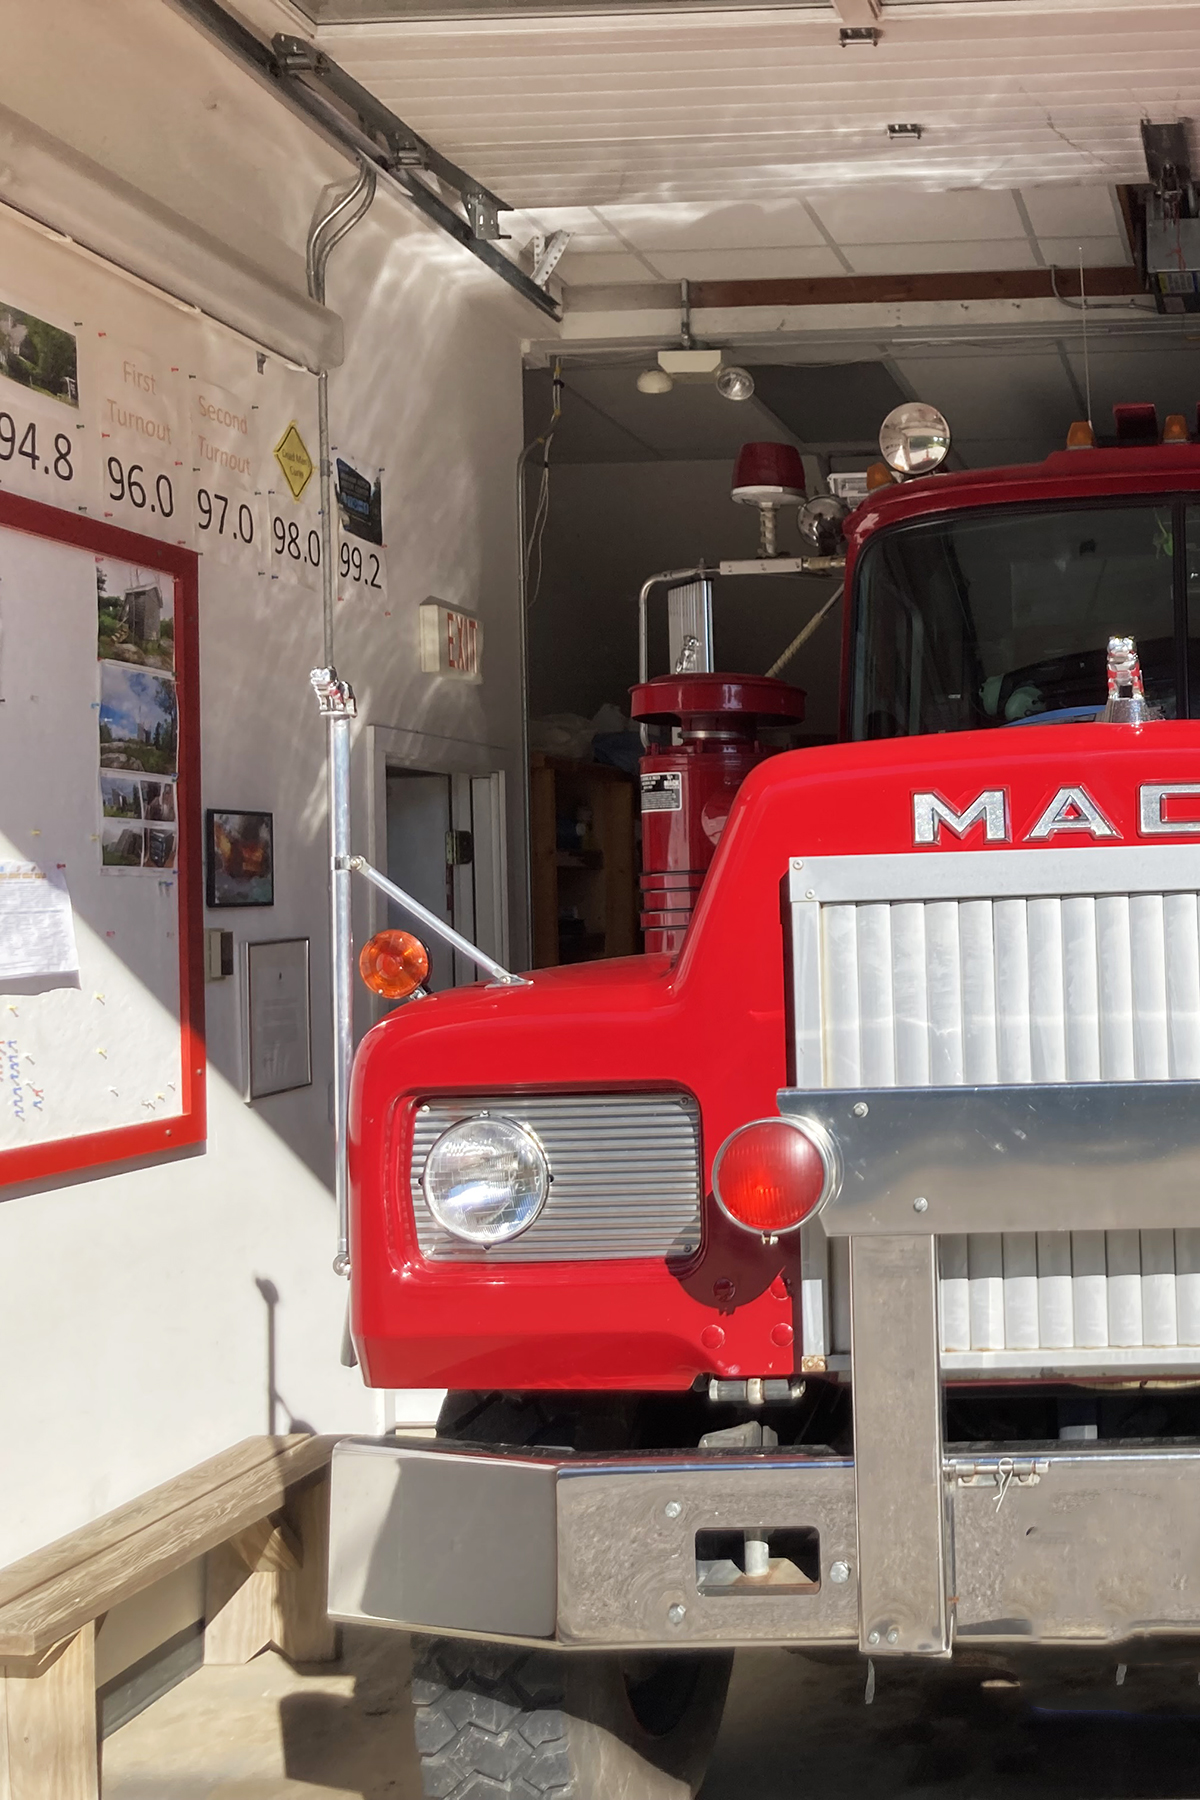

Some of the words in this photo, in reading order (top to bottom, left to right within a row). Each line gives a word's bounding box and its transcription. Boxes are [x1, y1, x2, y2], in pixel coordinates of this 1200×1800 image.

[122, 360, 157, 396] First
[106, 398, 172, 446] Turnout
[198, 394, 249, 436] Second
[0, 411, 74, 482] 94.8
[198, 434, 252, 477] Turnout
[107, 456, 174, 518] 96.0
[197, 488, 254, 544] 97.0
[273, 516, 321, 567] 98.0
[339, 541, 382, 589] 99.2
[447, 611, 478, 676] EXIT
